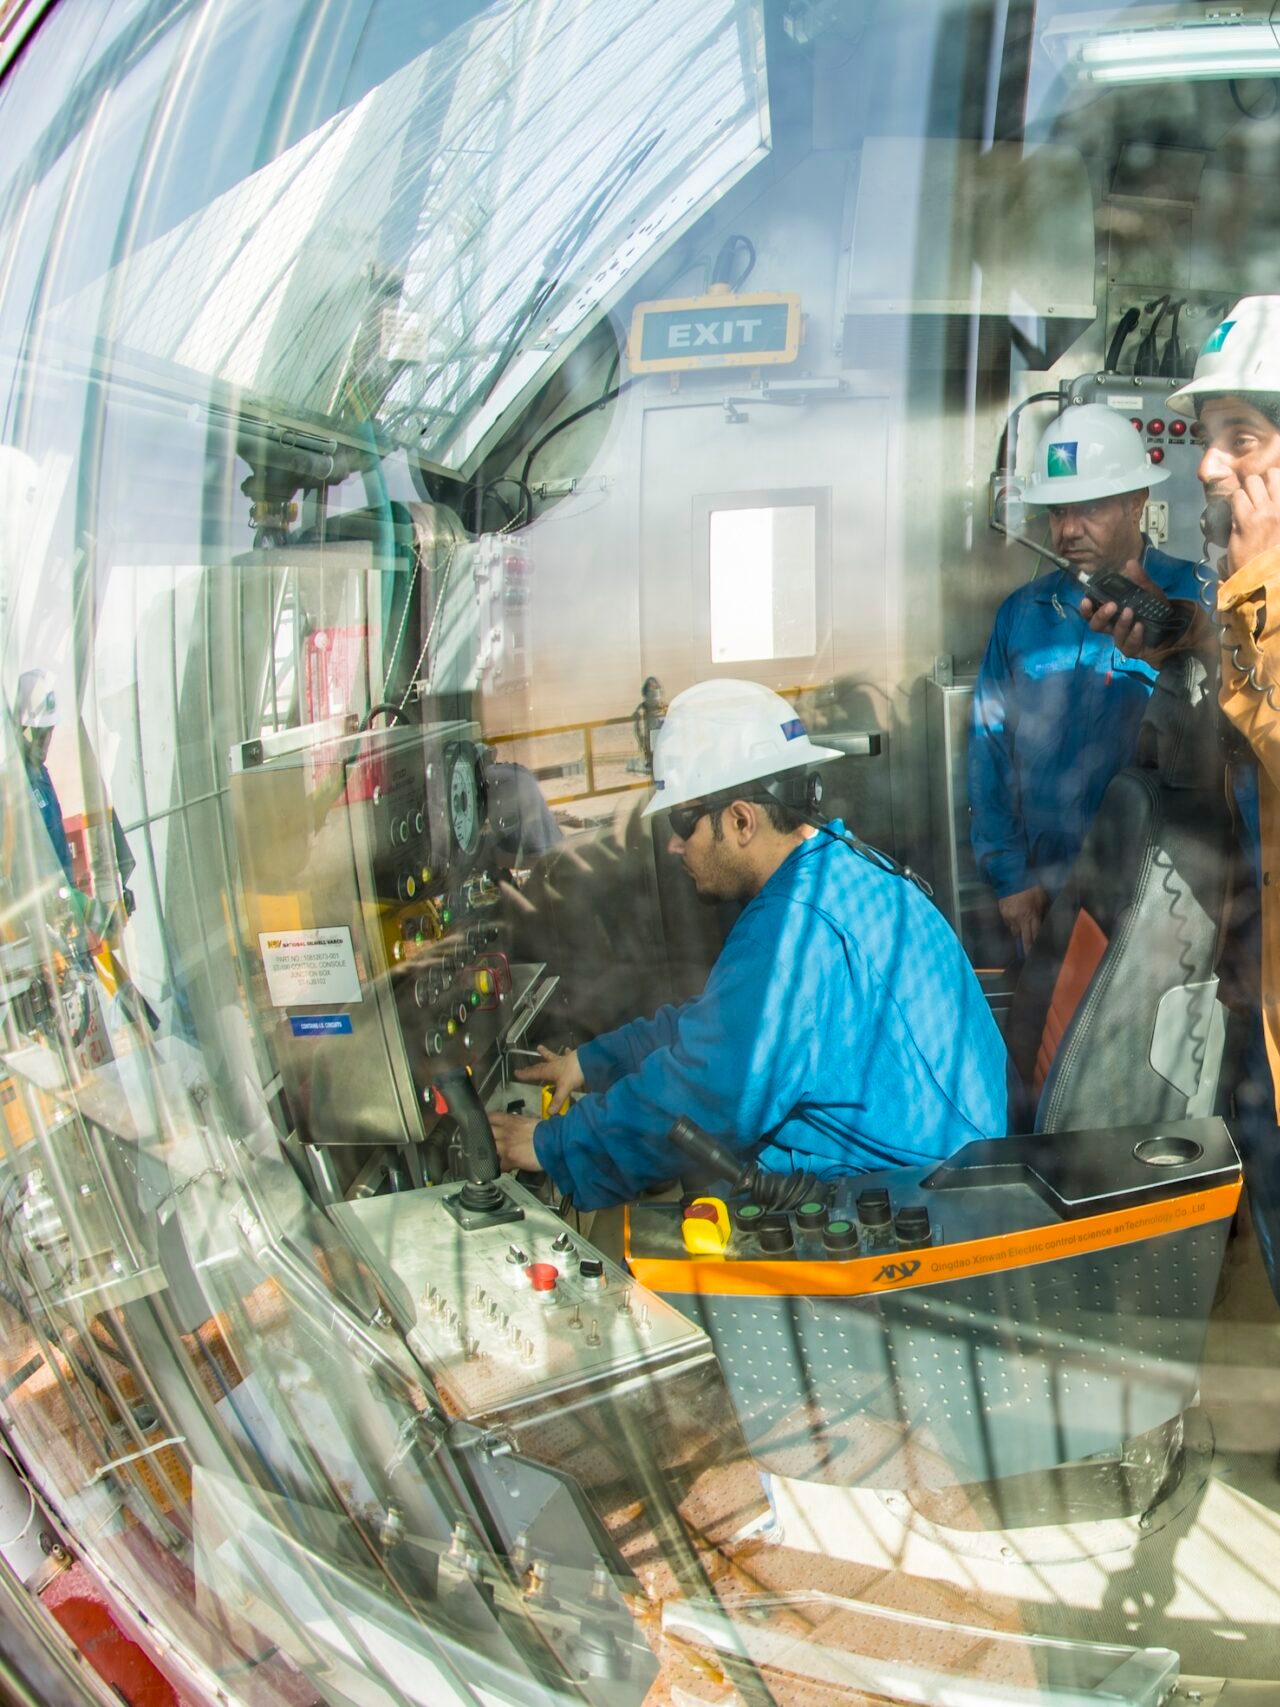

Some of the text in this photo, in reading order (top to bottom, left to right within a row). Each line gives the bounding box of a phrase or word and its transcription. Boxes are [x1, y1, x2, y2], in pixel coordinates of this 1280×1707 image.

[668, 319, 762, 348] EXIT
[290, 970, 317, 978] JUNCTON
[930, 1258, 971, 1273] Qingdao
[972, 1250, 1008, 1266] Xinwan
[1008, 1242, 1044, 1258] Electric
[1044, 1235, 1076, 1250] control
[1076, 1227, 1112, 1242] science
